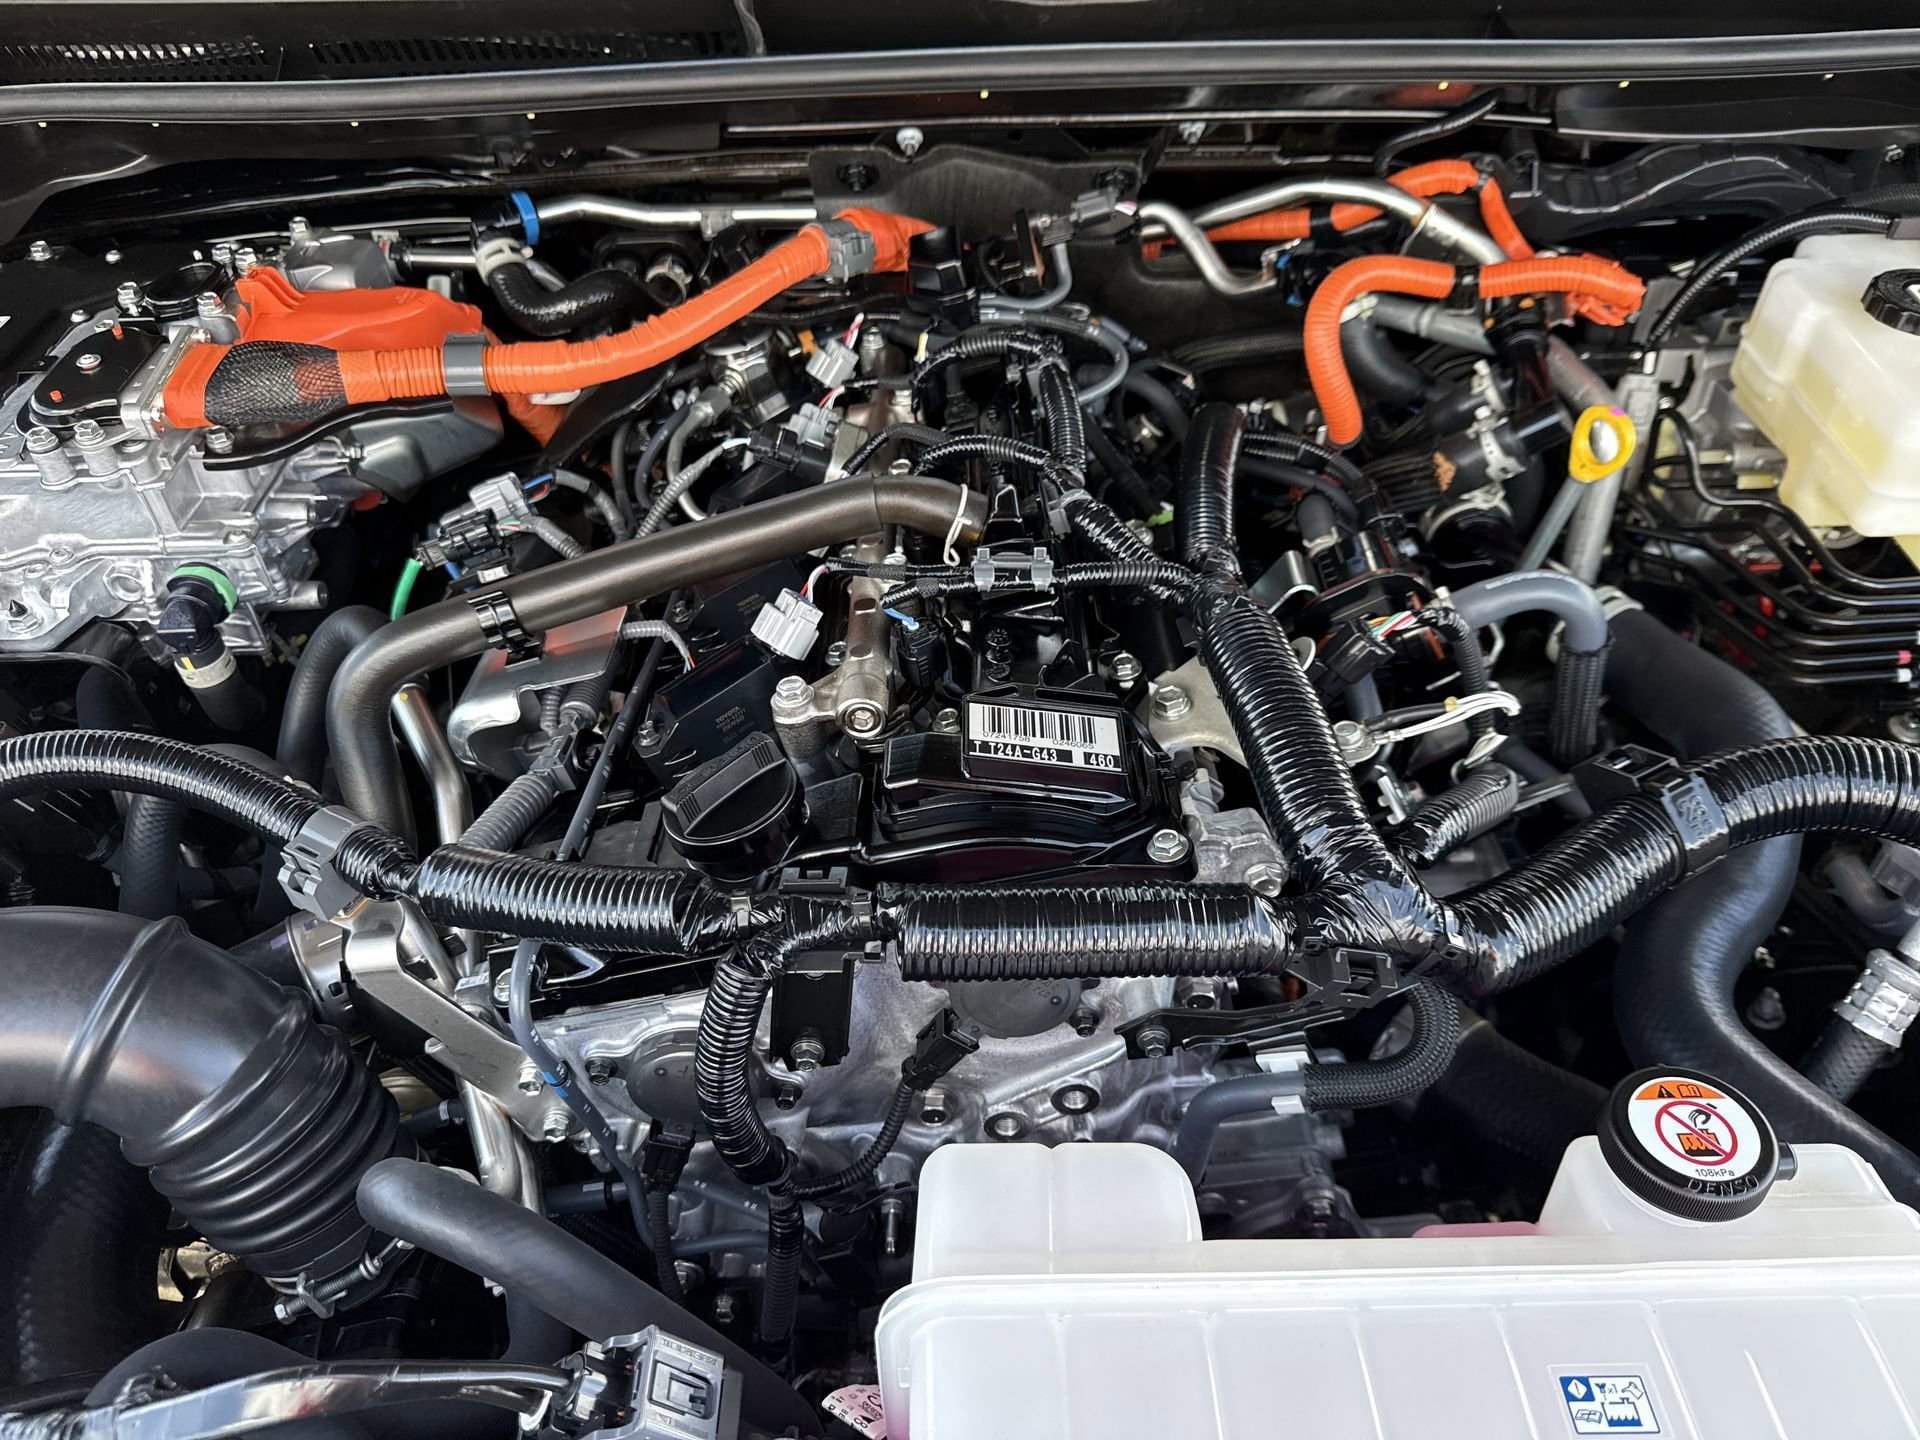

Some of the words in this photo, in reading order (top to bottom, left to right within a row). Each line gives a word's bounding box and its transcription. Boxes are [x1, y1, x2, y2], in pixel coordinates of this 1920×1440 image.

[714, 706, 741, 723] TOYOTA
[974, 740, 982, 753] T
[988, 742, 1057, 761] T24A-G43
[1089, 754, 1114, 767] 460
[1695, 1168, 1735, 1177] 108kPa
[1688, 1175, 1760, 1197] DENSO
